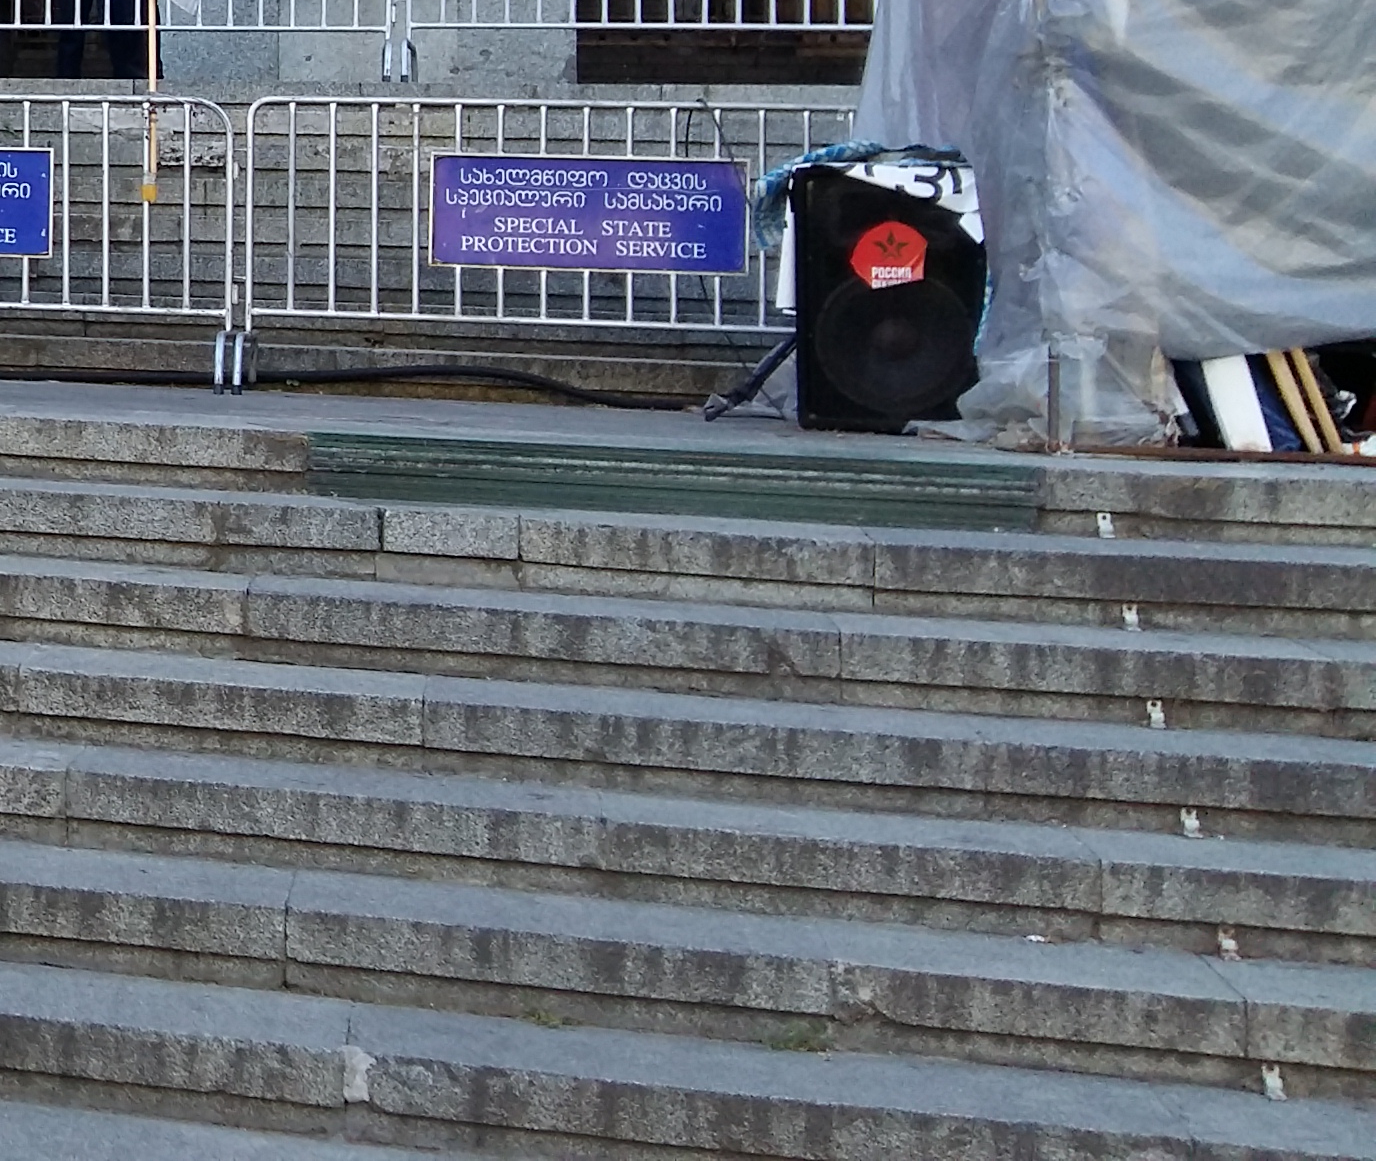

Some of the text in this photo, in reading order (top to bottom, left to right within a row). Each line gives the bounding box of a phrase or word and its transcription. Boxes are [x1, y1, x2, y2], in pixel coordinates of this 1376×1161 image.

[460, 168, 706, 190] სახელმწიფო დაცვის
[446, 188, 722, 212] სპეციალური სამსახური
[494, 217, 672, 238] SPECIAL STATE
[460, 237, 707, 259] PROTECTION SERVICE
